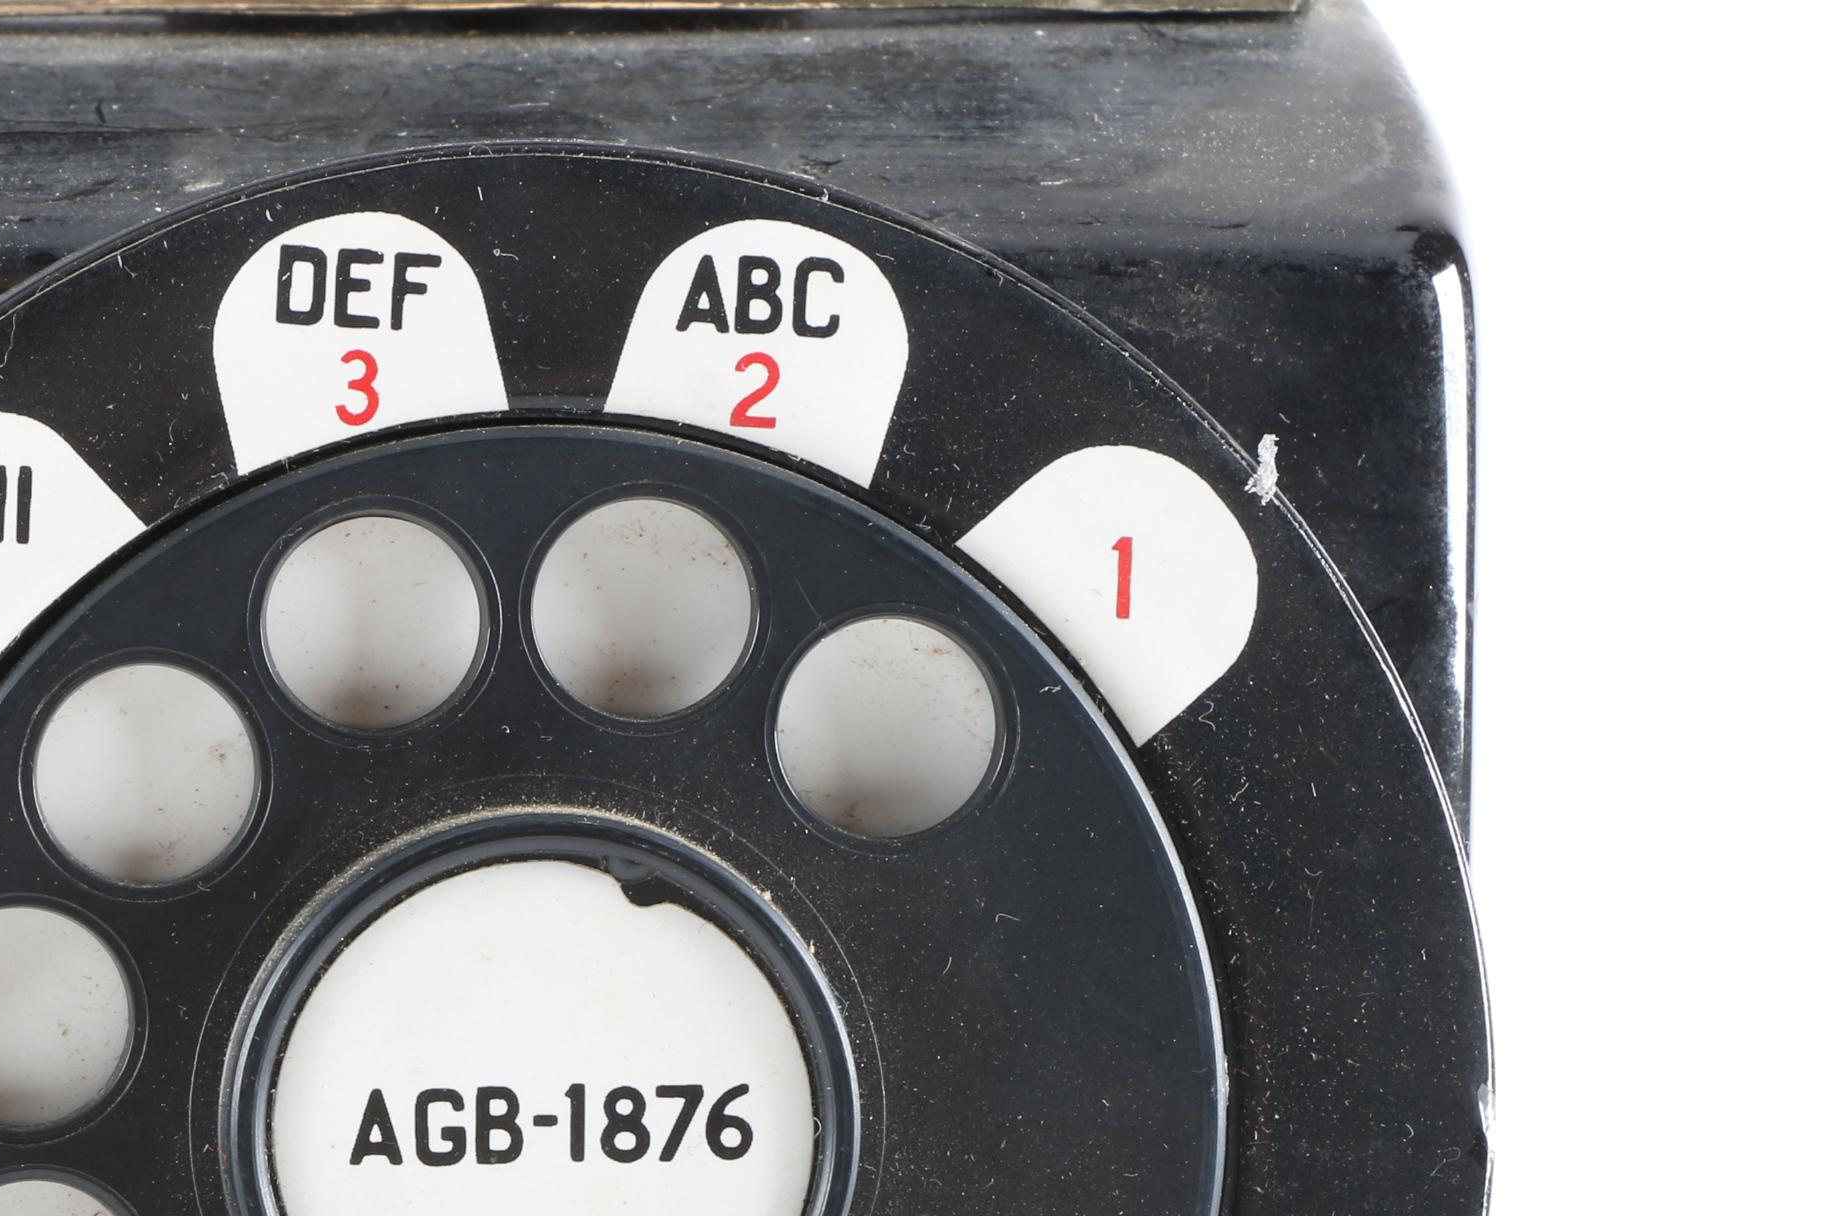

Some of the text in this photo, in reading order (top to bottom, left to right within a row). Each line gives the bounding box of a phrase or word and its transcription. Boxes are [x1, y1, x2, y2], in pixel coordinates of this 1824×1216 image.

[275, 244, 442, 331] DEF
[675, 254, 845, 339] ABC
[336, 349, 379, 426] 3
[730, 352, 780, 429] 2
[1113, 537, 1132, 619] 1
[349, 1083, 754, 1167] AGB-1876
